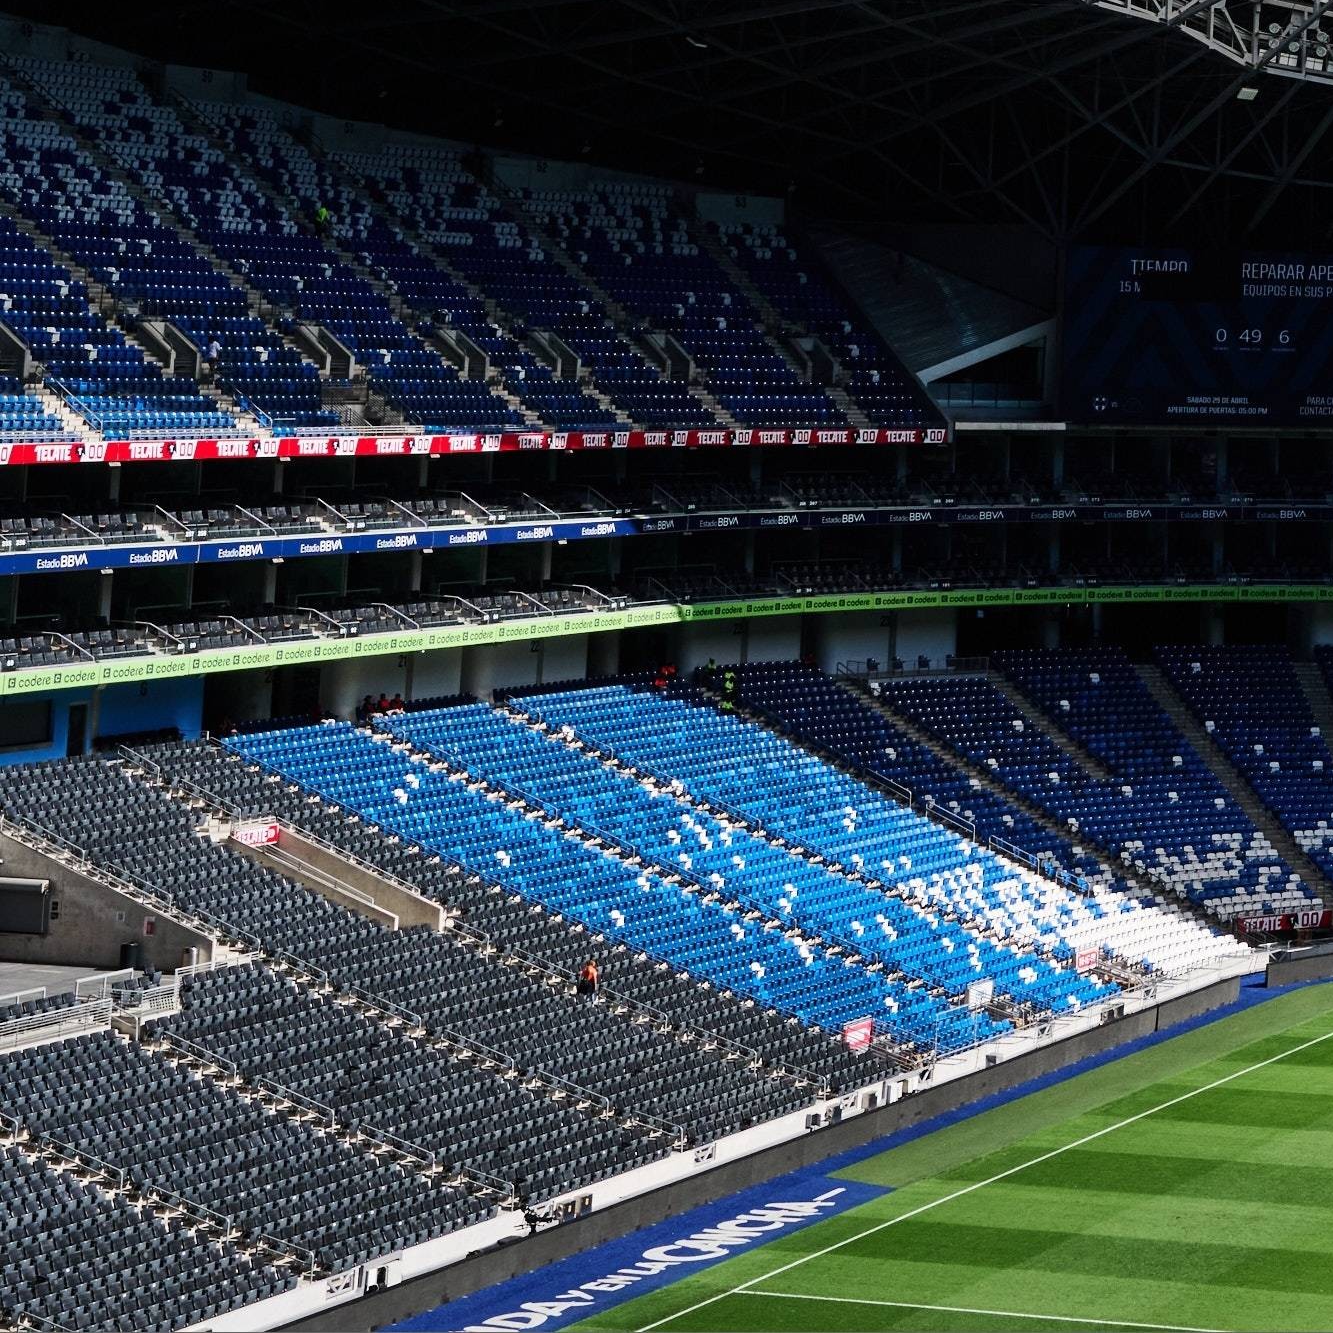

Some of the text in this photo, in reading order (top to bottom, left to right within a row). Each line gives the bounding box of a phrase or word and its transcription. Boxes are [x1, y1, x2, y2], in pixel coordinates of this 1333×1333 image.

[1119, 280, 1133, 293] 15
[1289, 286, 1302, 298] EN
[1304, 286, 1324, 298] SUS
[1239, 329, 1262, 343] 49
[1279, 329, 1290, 343] 6
[1306, 396, 1325, 405] PARA
[448, 434, 477, 451] TECATE
[518, 434, 544, 449] TECATE
[582, 432, 606, 448] TECATE
[644, 432, 667, 446] TECATE
[697, 431, 725, 446] TECATE
[758, 431, 785, 445] TECATE
[816, 430, 847, 444] TECATE
[886, 430, 916, 443] TECATE
[128, 443, 165, 460] TECATE
[215, 441, 250, 457] TECATE
[297, 437, 329, 454] TECATE
[375, 437, 405, 453] TECATE
[34, 444, 73, 462] TECATE
[957, 511, 1004, 521] Estadio BBVA
[1202, 509, 1228, 518] BBVA
[582, 522, 616, 536] Estadio BBVA
[699, 517, 738, 528] Estadio BBVA
[449, 529, 487, 544] Estadio BBVA
[517, 526, 553, 540] Estadio BBVA
[300, 539, 343, 554] Estadio BBVA
[376, 534, 417, 549] Estadio BBVA
[129, 548, 177, 564] Estadio BBVA
[218, 543, 263, 559] Estadio BBVA
[37, 553, 88, 570] Estadio BBVA
[814, 597, 870, 609] codere codere
[505, 623, 560, 637] codere codere
[363, 637, 424, 651] codere codere
[202, 653, 270, 669] codere codere
[113, 662, 186, 678] codere codere
[18, 671, 96, 688] codere codere
[1243, 915, 1283, 933] TECATE
[565, 1289, 593, 1302] Y
[589, 1269, 642, 1292] EN
[635, 1261, 682, 1279] LA
